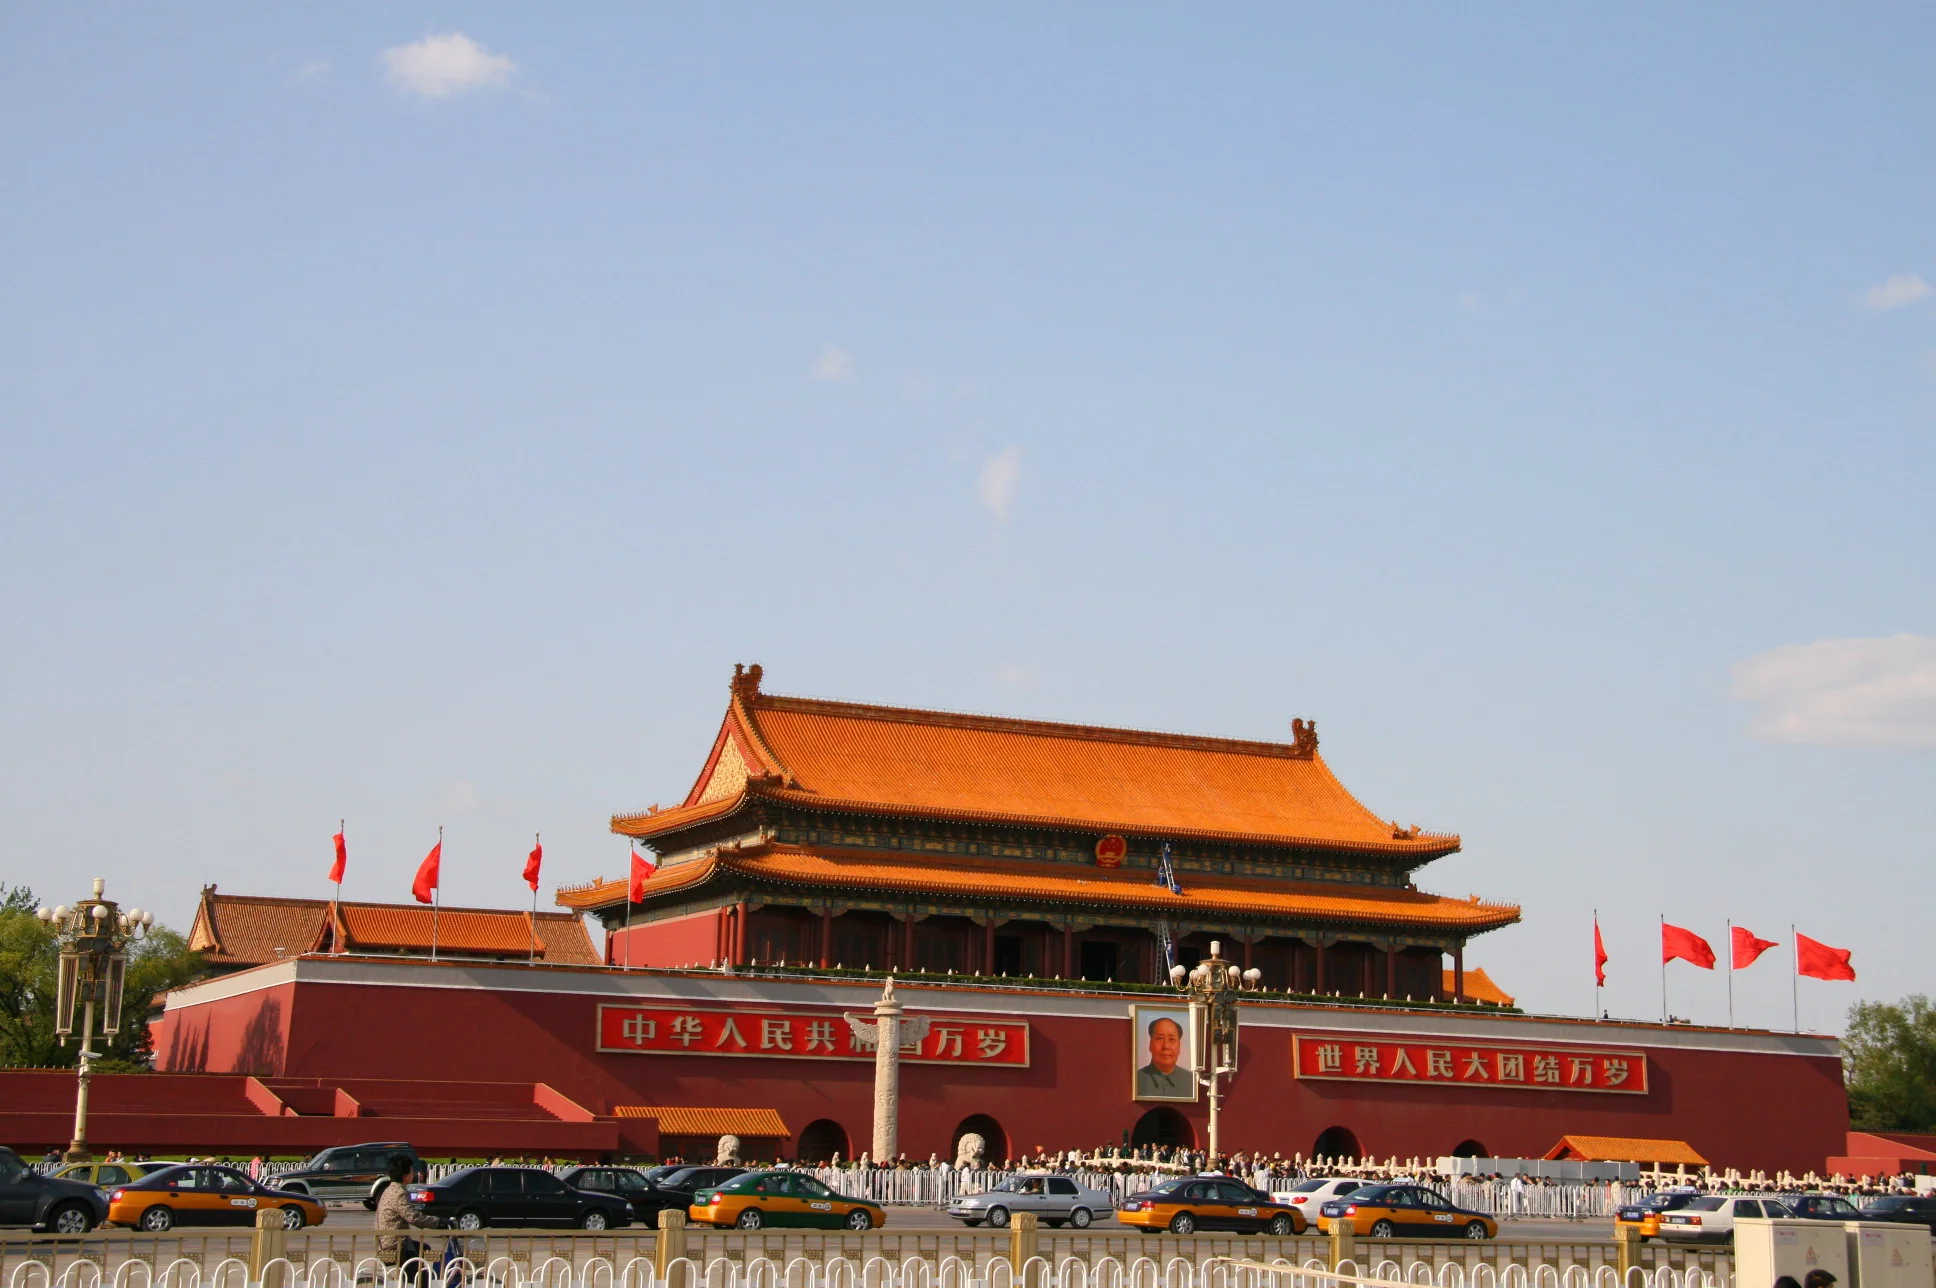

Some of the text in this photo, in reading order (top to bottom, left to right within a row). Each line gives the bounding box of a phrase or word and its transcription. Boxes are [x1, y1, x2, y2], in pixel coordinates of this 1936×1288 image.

[1315, 1044, 1629, 1086] 世界人民大团结万岁
